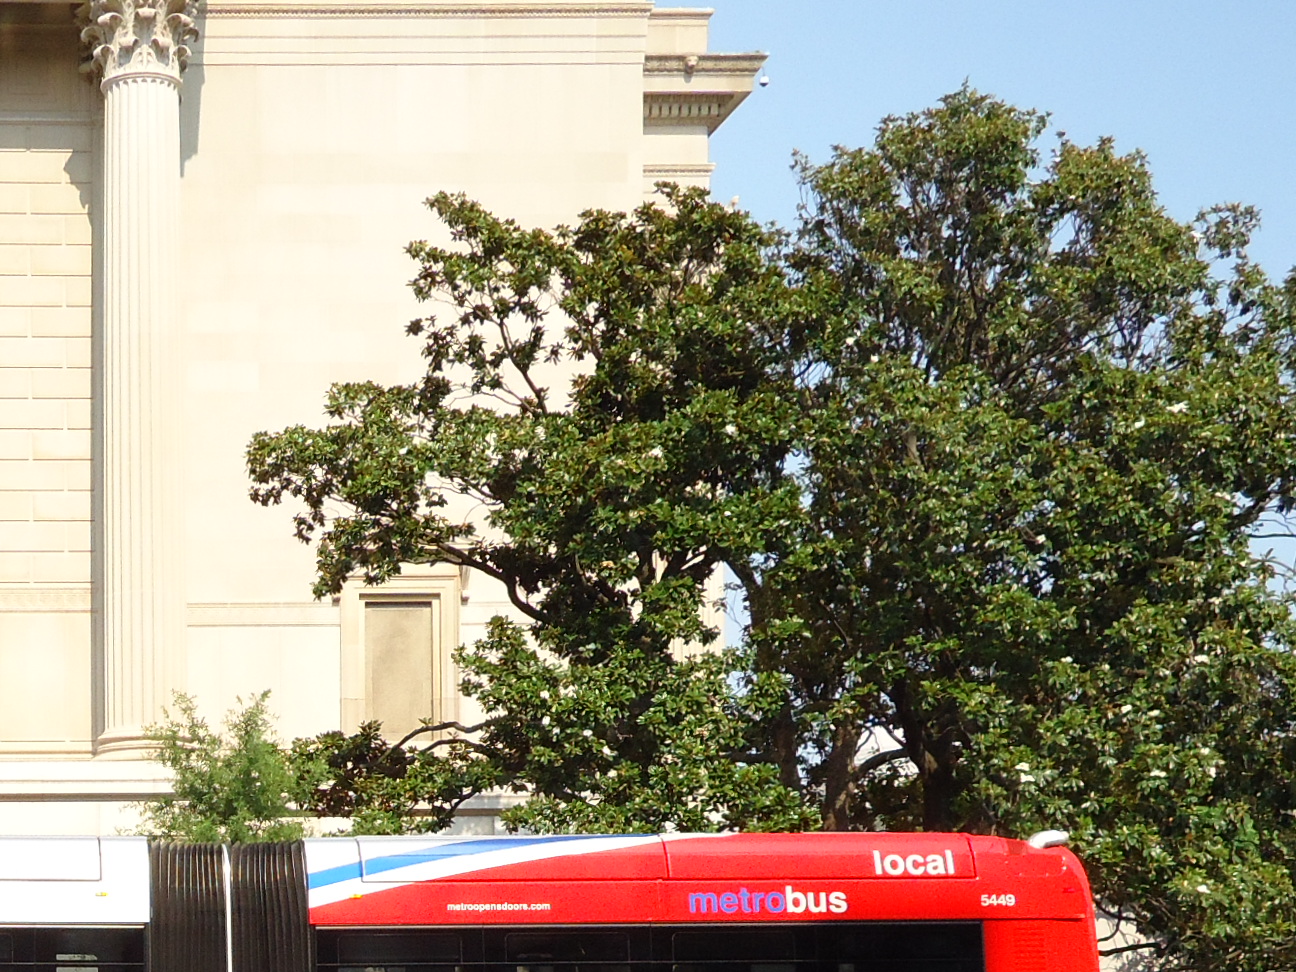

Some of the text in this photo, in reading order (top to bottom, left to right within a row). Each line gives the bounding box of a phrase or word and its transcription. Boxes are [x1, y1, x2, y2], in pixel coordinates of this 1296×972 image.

[873, 849, 955, 876] local
[446, 901, 551, 913] metroopensdoors.com
[689, 886, 848, 915] metrobus
[980, 894, 1016, 907] 5449
